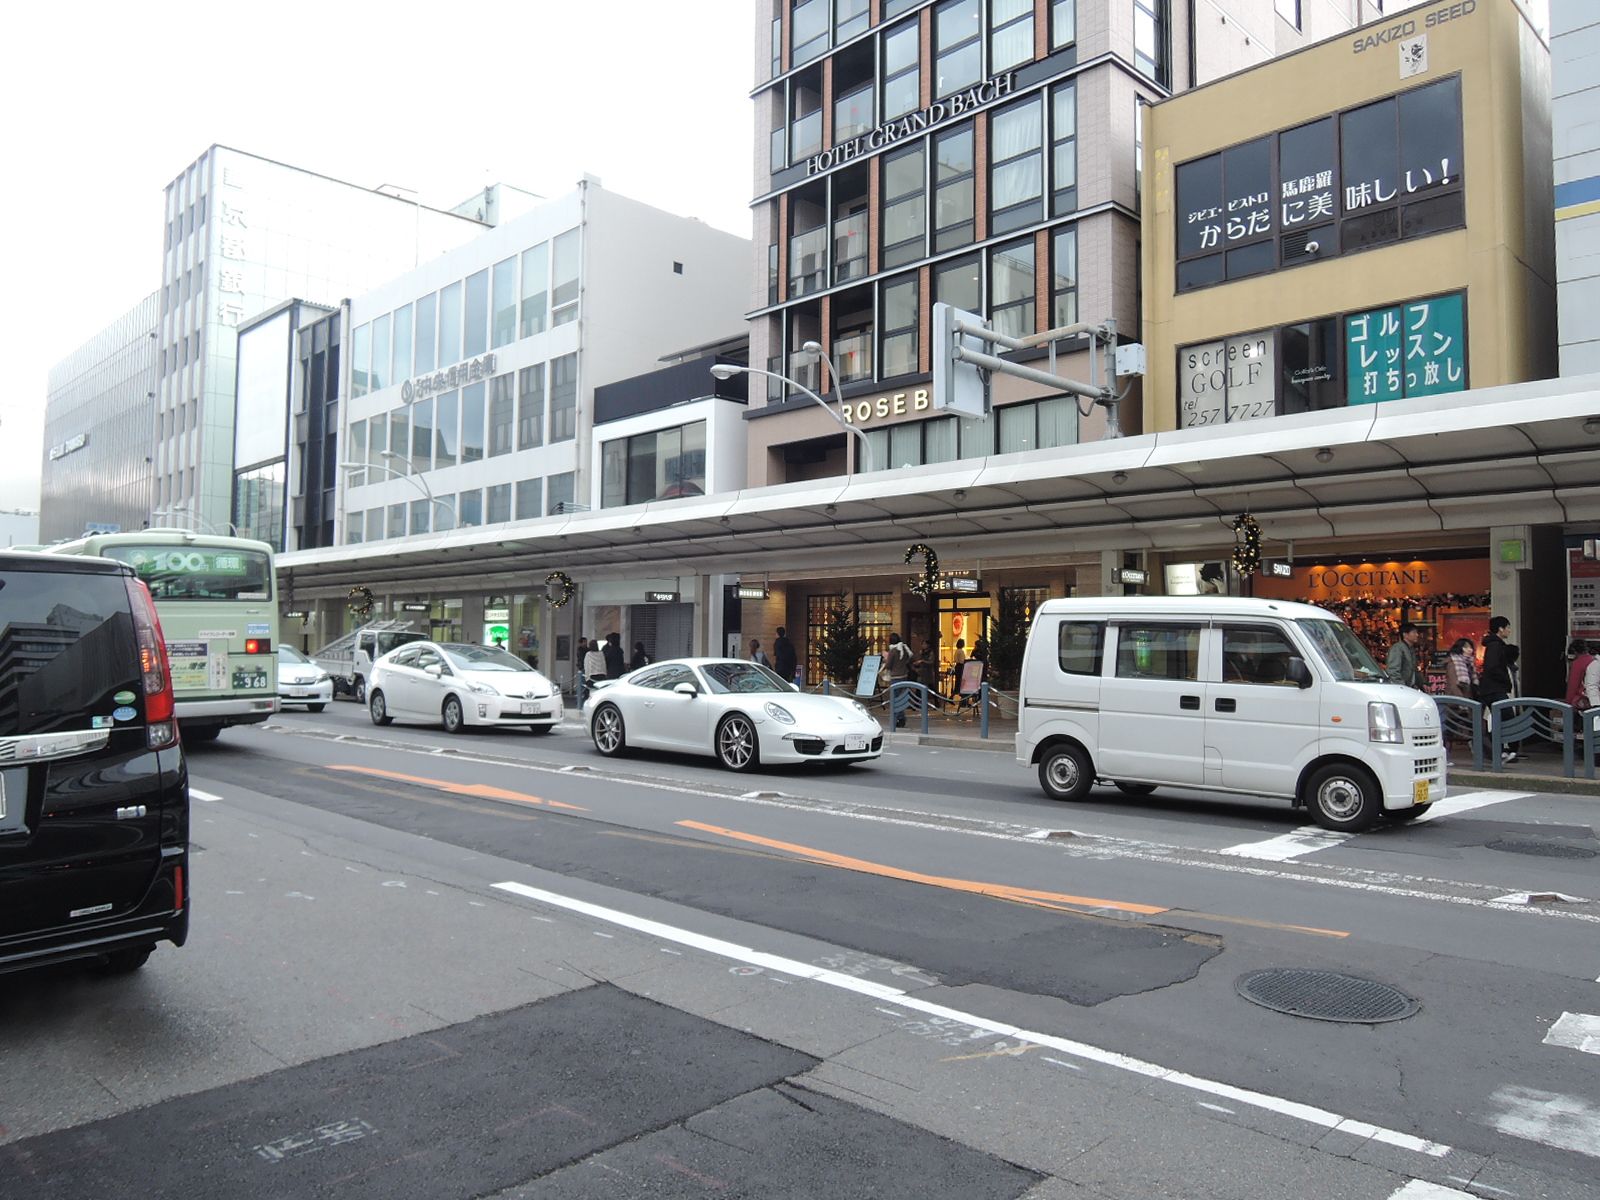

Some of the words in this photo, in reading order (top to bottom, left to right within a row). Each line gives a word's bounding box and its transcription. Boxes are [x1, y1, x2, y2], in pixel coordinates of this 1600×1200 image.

[1353, 20, 1415, 54] SAKIZO
[1425, 0, 1476, 28] SEED
[806, 137, 867, 177] HOTEL
[869, 103, 945, 149] GRAND
[951, 72, 1017, 116] BACH
[1351, 304, 1429, 342] ゴルフ
[1188, 340, 1266, 369] screen
[1360, 331, 1452, 368] レッスン
[1191, 361, 1263, 394] GOLF
[1363, 357, 1461, 395] 打ちっ放し
[842, 391, 907, 423] ROSE
[1184, 397, 1199, 411] tel
[1187, 408, 1221, 427] 257
[1226, 400, 1274, 422] 7727
